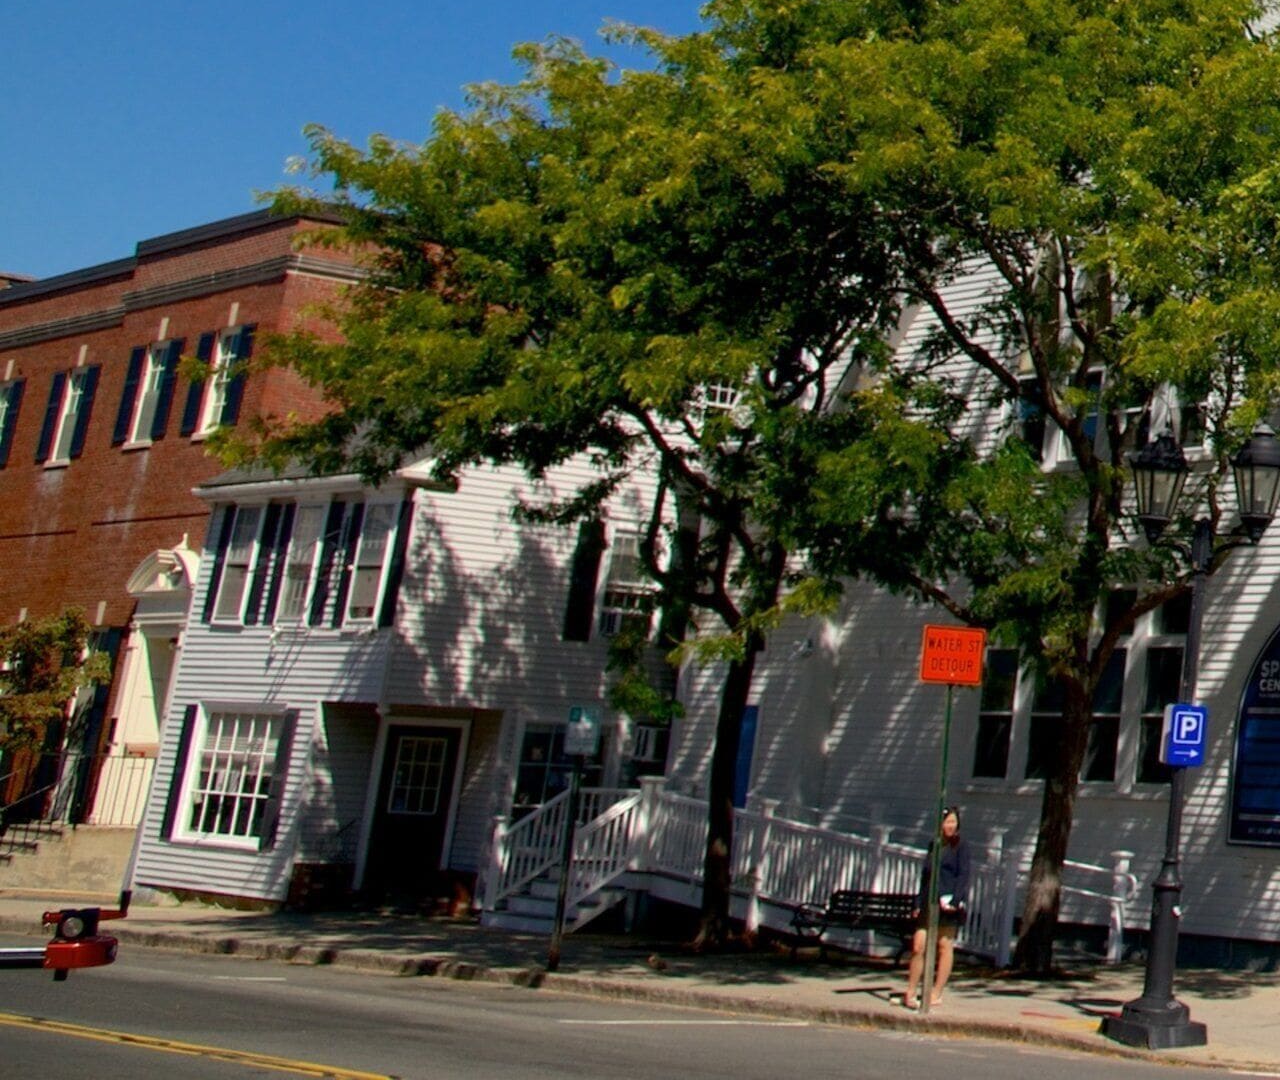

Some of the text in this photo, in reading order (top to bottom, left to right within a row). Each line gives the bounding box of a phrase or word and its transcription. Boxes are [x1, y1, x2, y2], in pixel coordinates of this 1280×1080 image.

[929, 637, 980, 652] WATER ST
[931, 657, 974, 672] DETOUR
[1181, 716, 1198, 739] P
